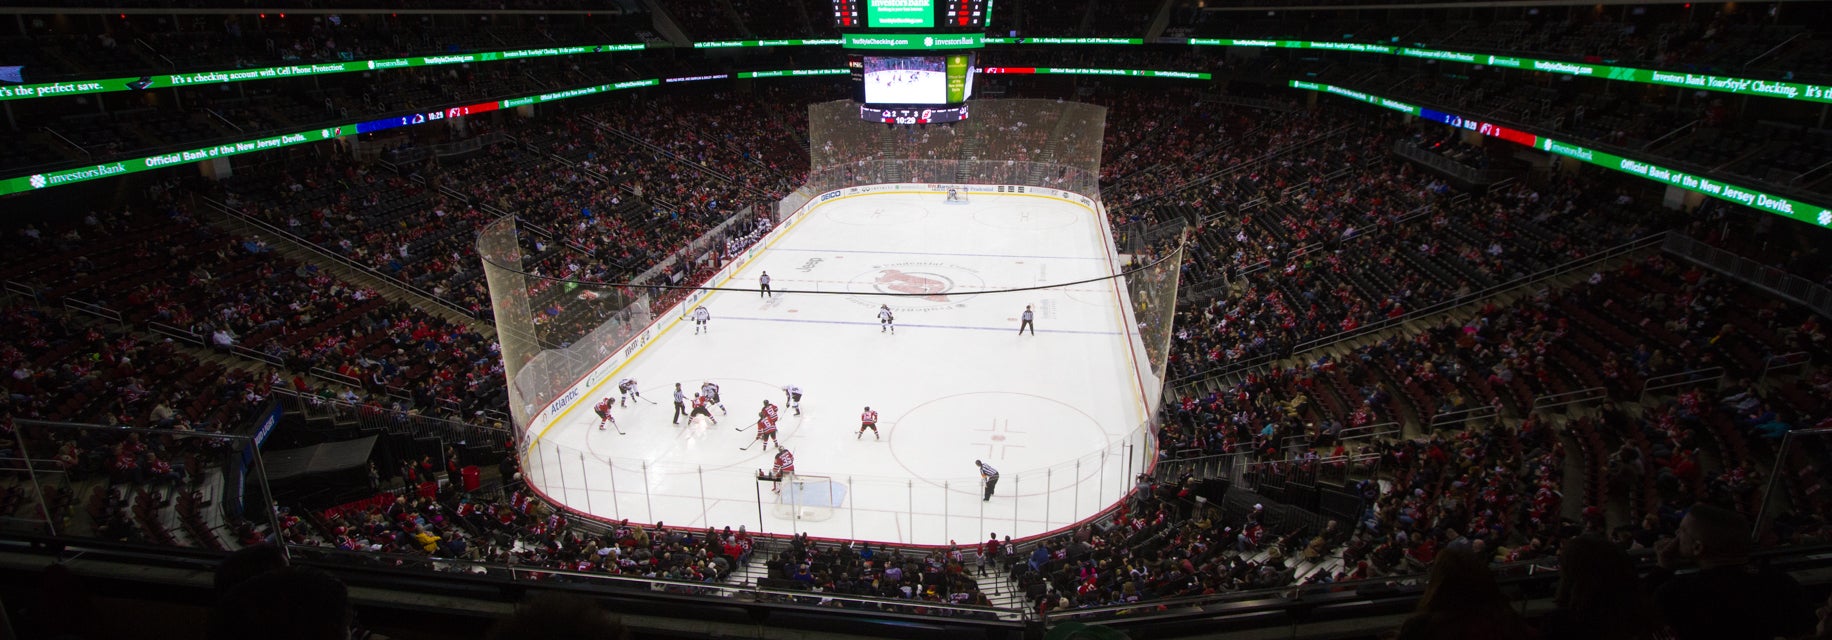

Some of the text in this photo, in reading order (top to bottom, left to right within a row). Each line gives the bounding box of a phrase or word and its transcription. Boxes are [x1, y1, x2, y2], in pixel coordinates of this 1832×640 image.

[934, 37, 974, 45] investorsBank
[171, 75, 185, 84] It's
[194, 72, 229, 82] checking
[230, 71, 258, 79] account
[260, 68, 276, 76] with
[277, 66, 290, 75] Cell
[292, 66, 311, 74] Phone
[14, 85, 33, 96] the
[37, 82, 75, 97] perfect
[77, 82, 103, 91] save.
[1652, 71, 1684, 82] Investors
[1685, 74, 1706, 86] Bank
[1752, 80, 1799, 98] Checking.
[1805, 85, 1822, 98] It's
[402, 117, 407, 125] 2
[896, 116, 916, 125] 10:29
[145, 134, 306, 167] Official Bank of the New Jersey Devils.
[48, 163, 125, 184] investorsBank
[1621, 159, 1795, 214] Official Bank of the New Jersey Devils.
[820, 190, 840, 201] GEICO
[551, 388, 579, 415] Atlantic
[782, 454, 792, 466] 35
